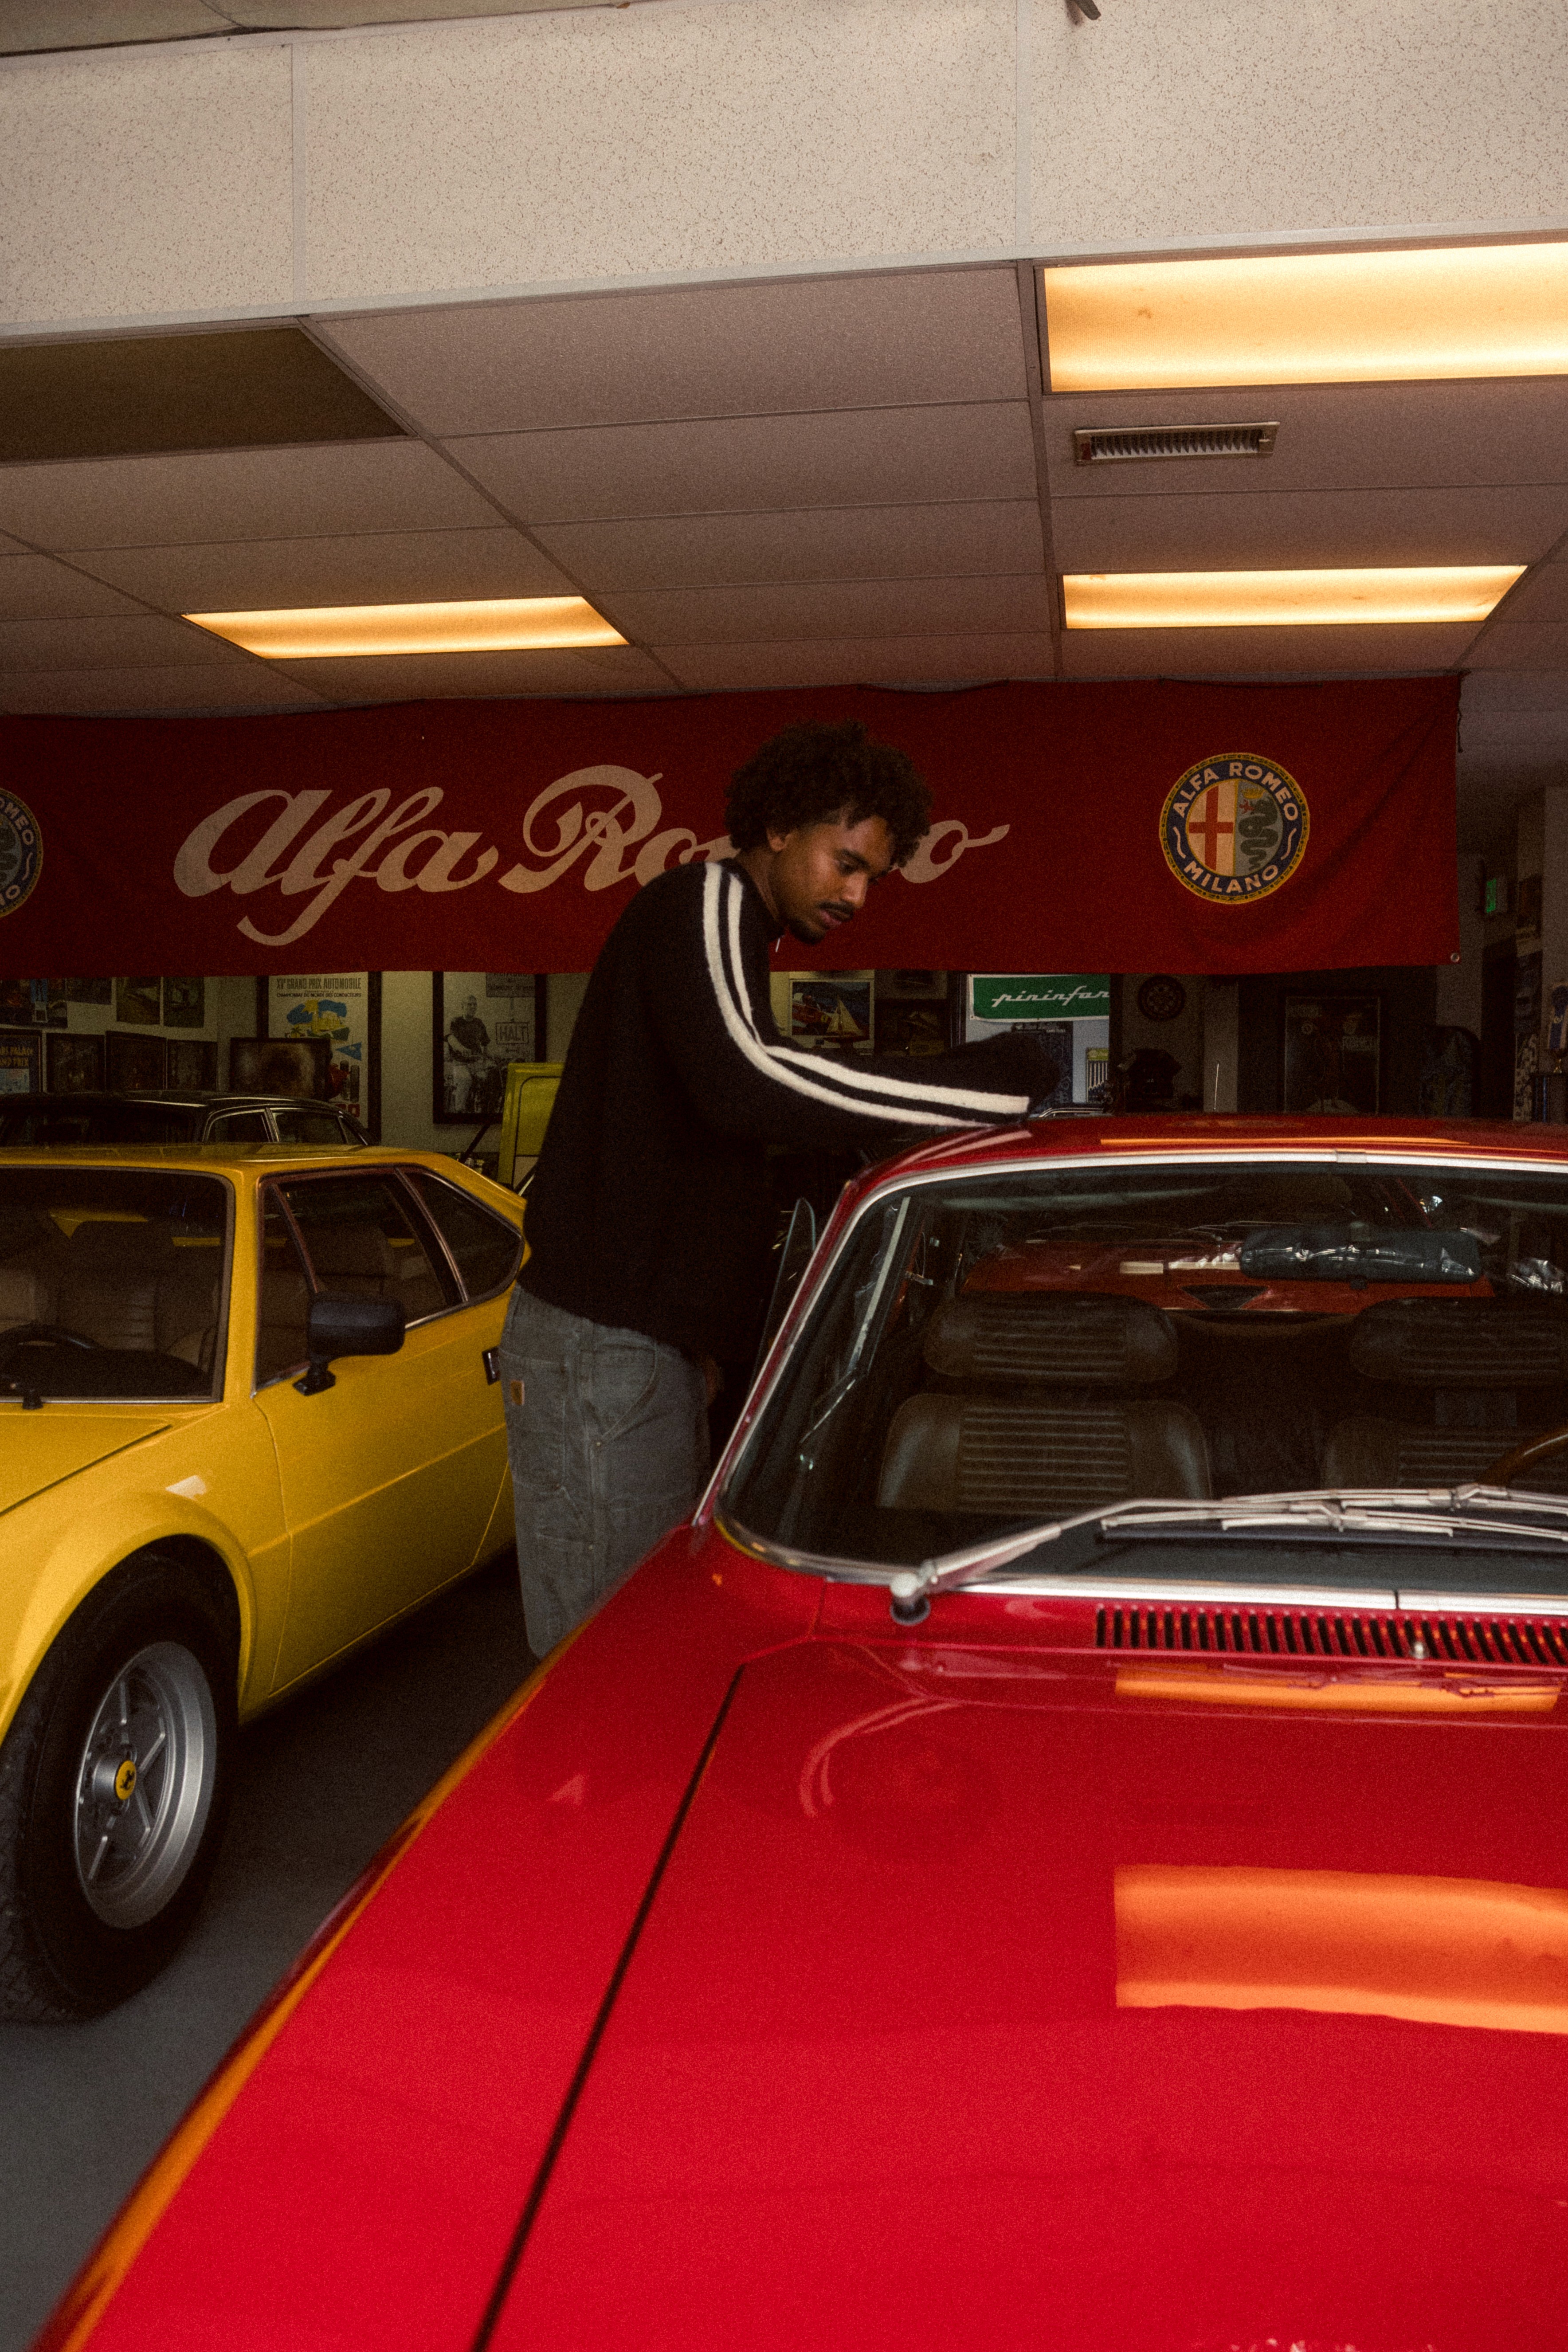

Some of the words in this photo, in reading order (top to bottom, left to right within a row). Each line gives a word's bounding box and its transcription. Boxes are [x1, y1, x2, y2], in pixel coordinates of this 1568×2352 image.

[1173, 767, 1219, 818] ALFA
[1229, 762, 1298, 821] ROMEO
[498, 764, 1011, 894] Roo
[1184, 860, 1278, 894] MILANO
[287, 978, 307, 989] GRAND
[308, 978, 322, 989] PRIX
[323, 977, 361, 989] AUTOMOBILE
[499, 1025, 527, 1041] HALT
